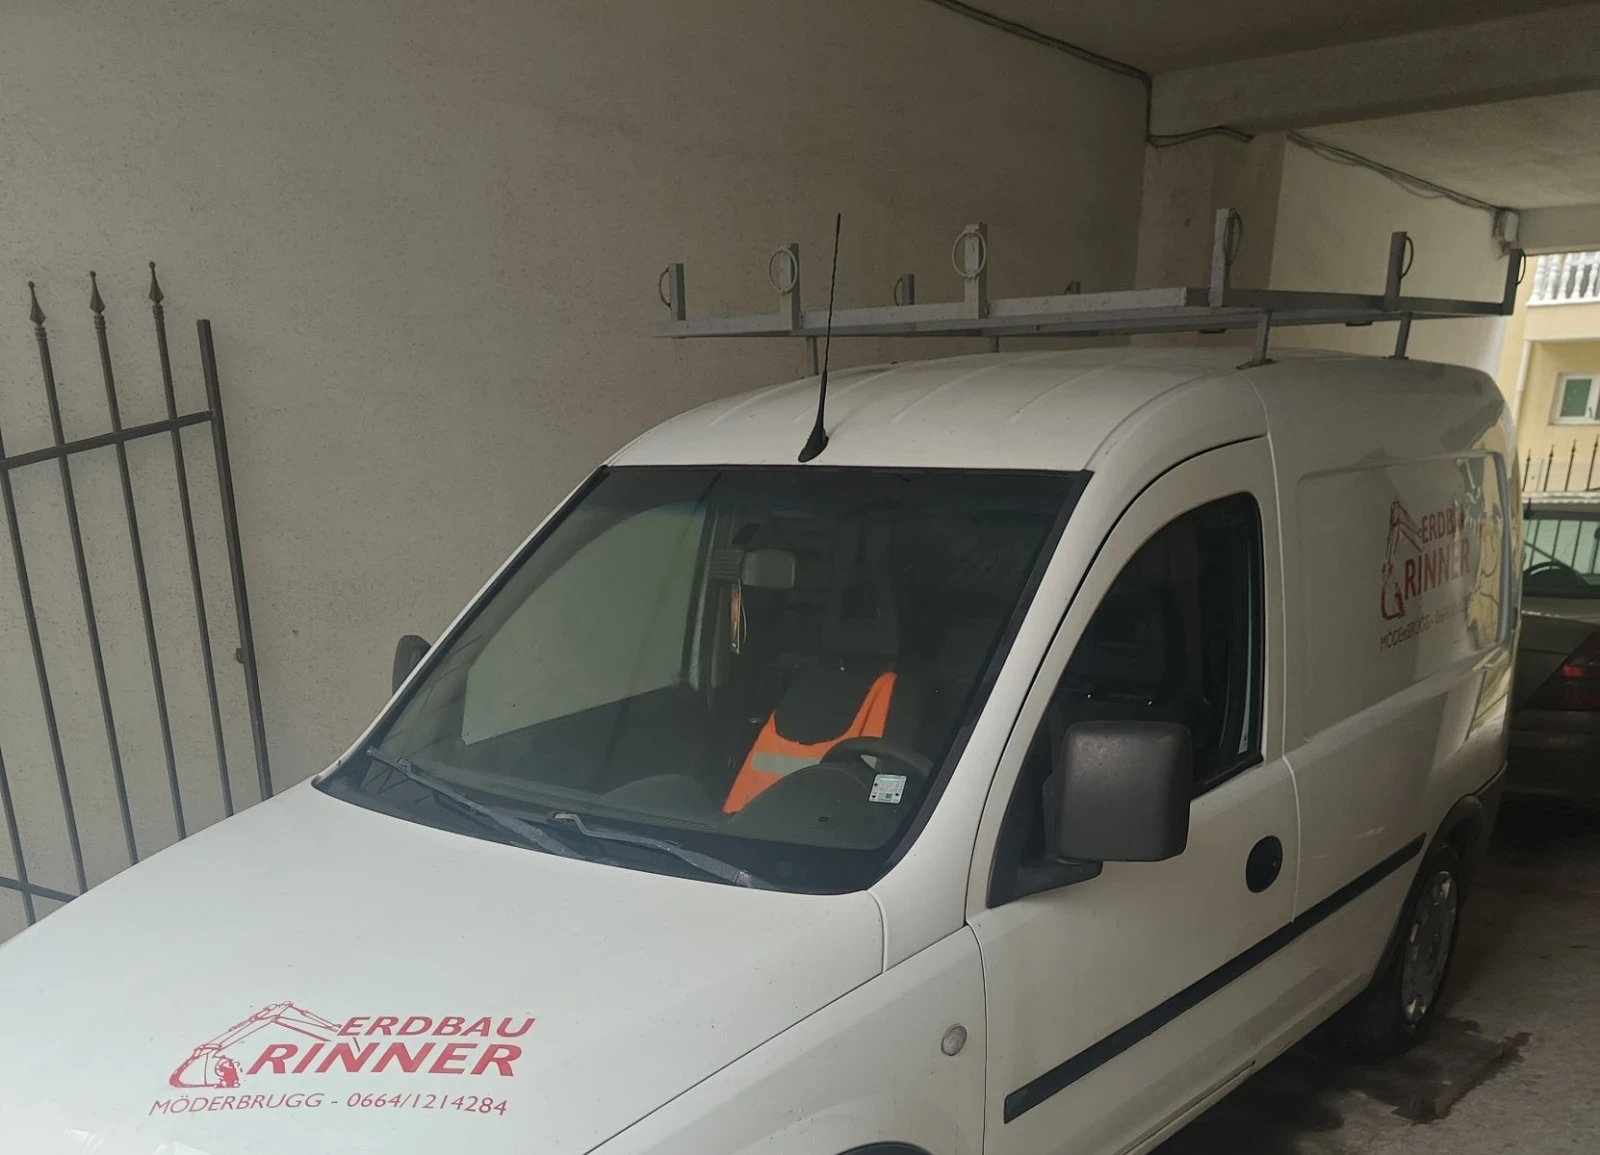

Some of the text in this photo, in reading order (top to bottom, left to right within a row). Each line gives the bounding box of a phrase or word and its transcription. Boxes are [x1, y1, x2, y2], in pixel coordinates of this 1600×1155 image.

[1405, 538, 1470, 600] RINNER
[337, 1016, 536, 1038] ERDBAU
[246, 1042, 523, 1077] RINNER
[149, 1093, 325, 1116] MÖDERBRUGG
[347, 1093, 508, 1116] 0664/1214284
